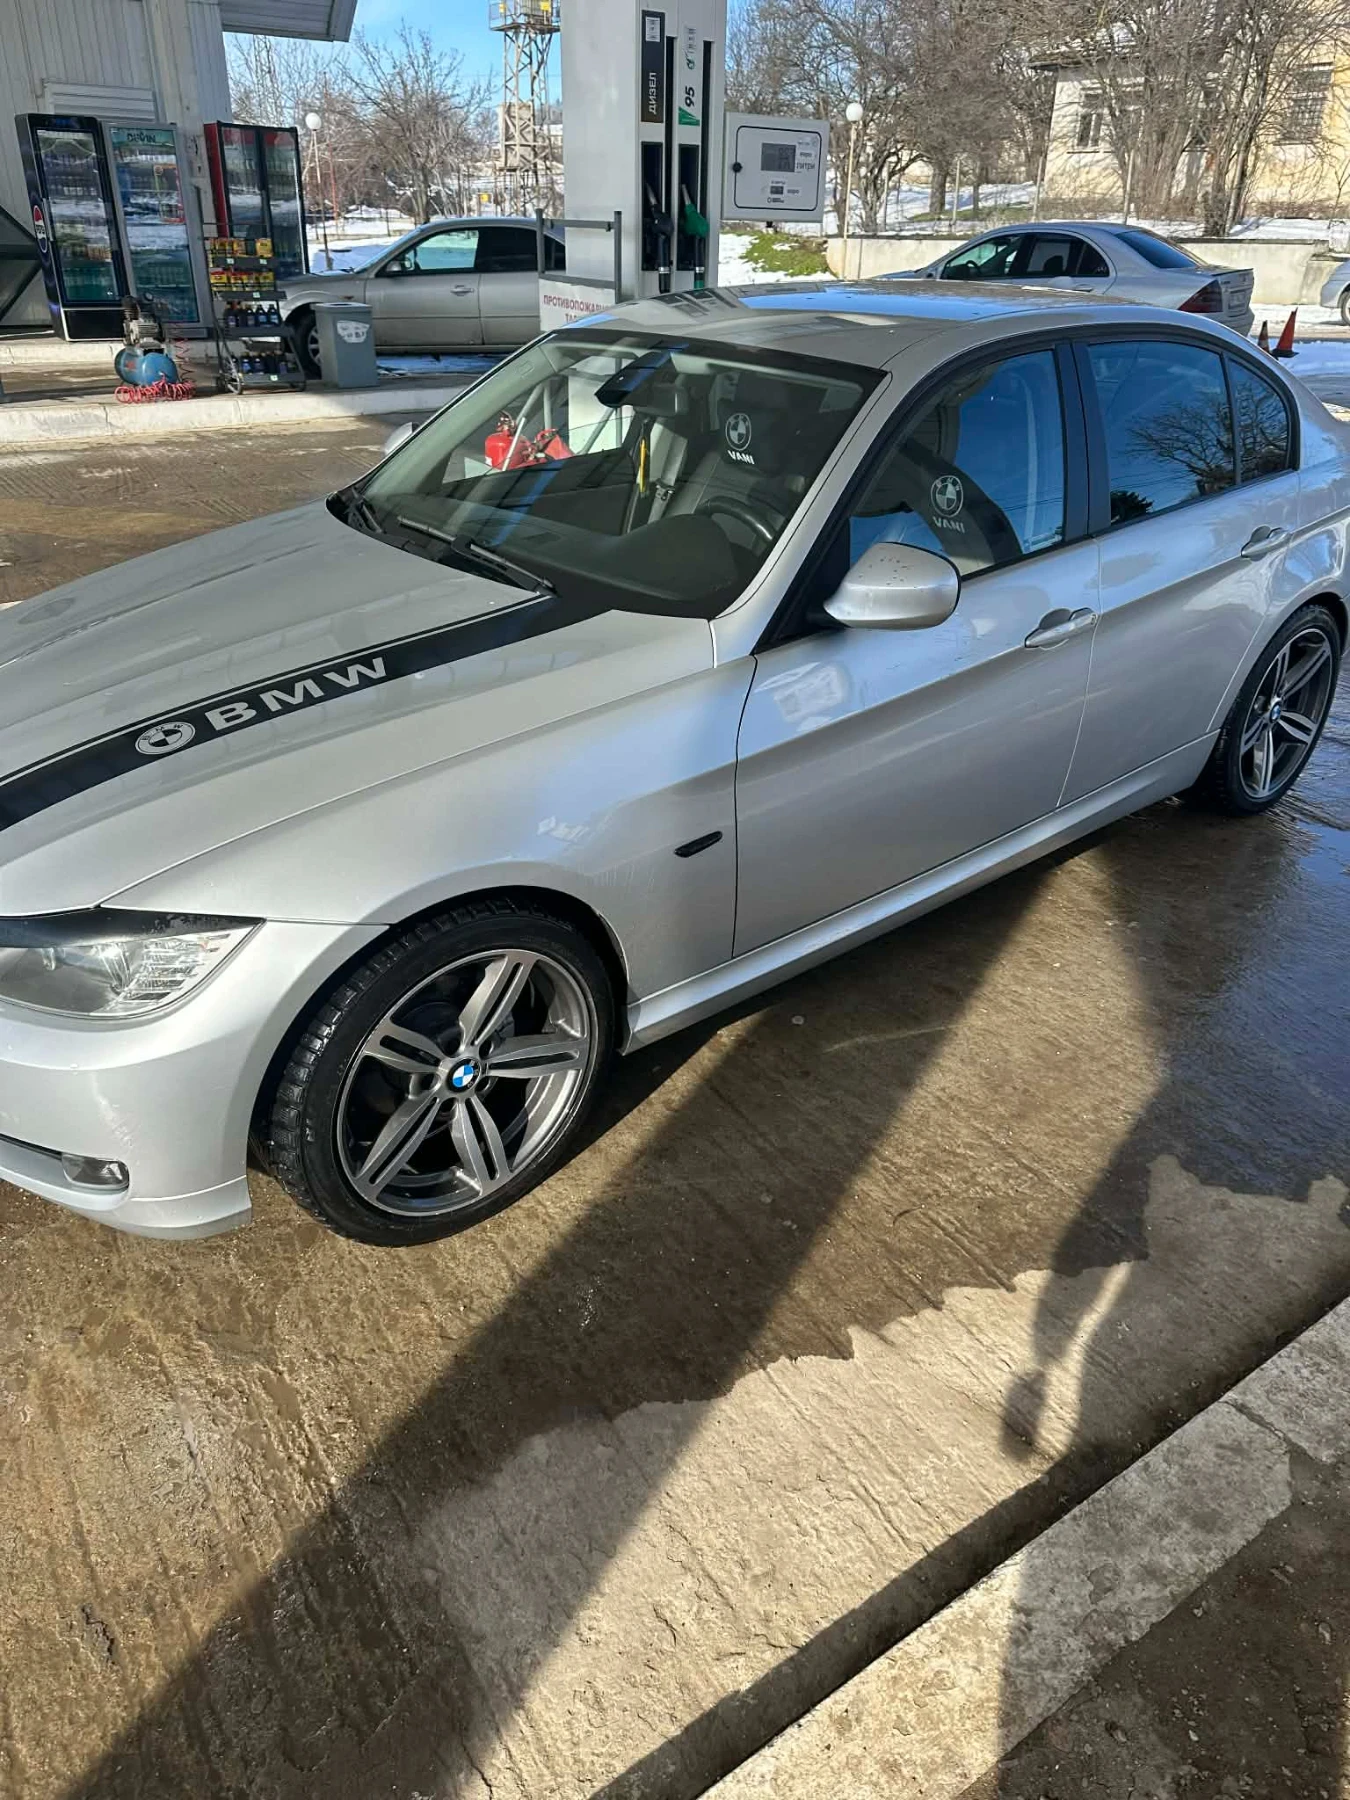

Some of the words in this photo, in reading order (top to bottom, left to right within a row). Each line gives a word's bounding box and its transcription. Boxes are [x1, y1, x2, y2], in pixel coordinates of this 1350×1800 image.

[648, 72, 658, 115] ДИЗЕЛ
[684, 86, 695, 108] 95
[727, 449, 755, 465] VANI
[932, 515, 965, 534] VANI
[204, 656, 388, 732] BMW
